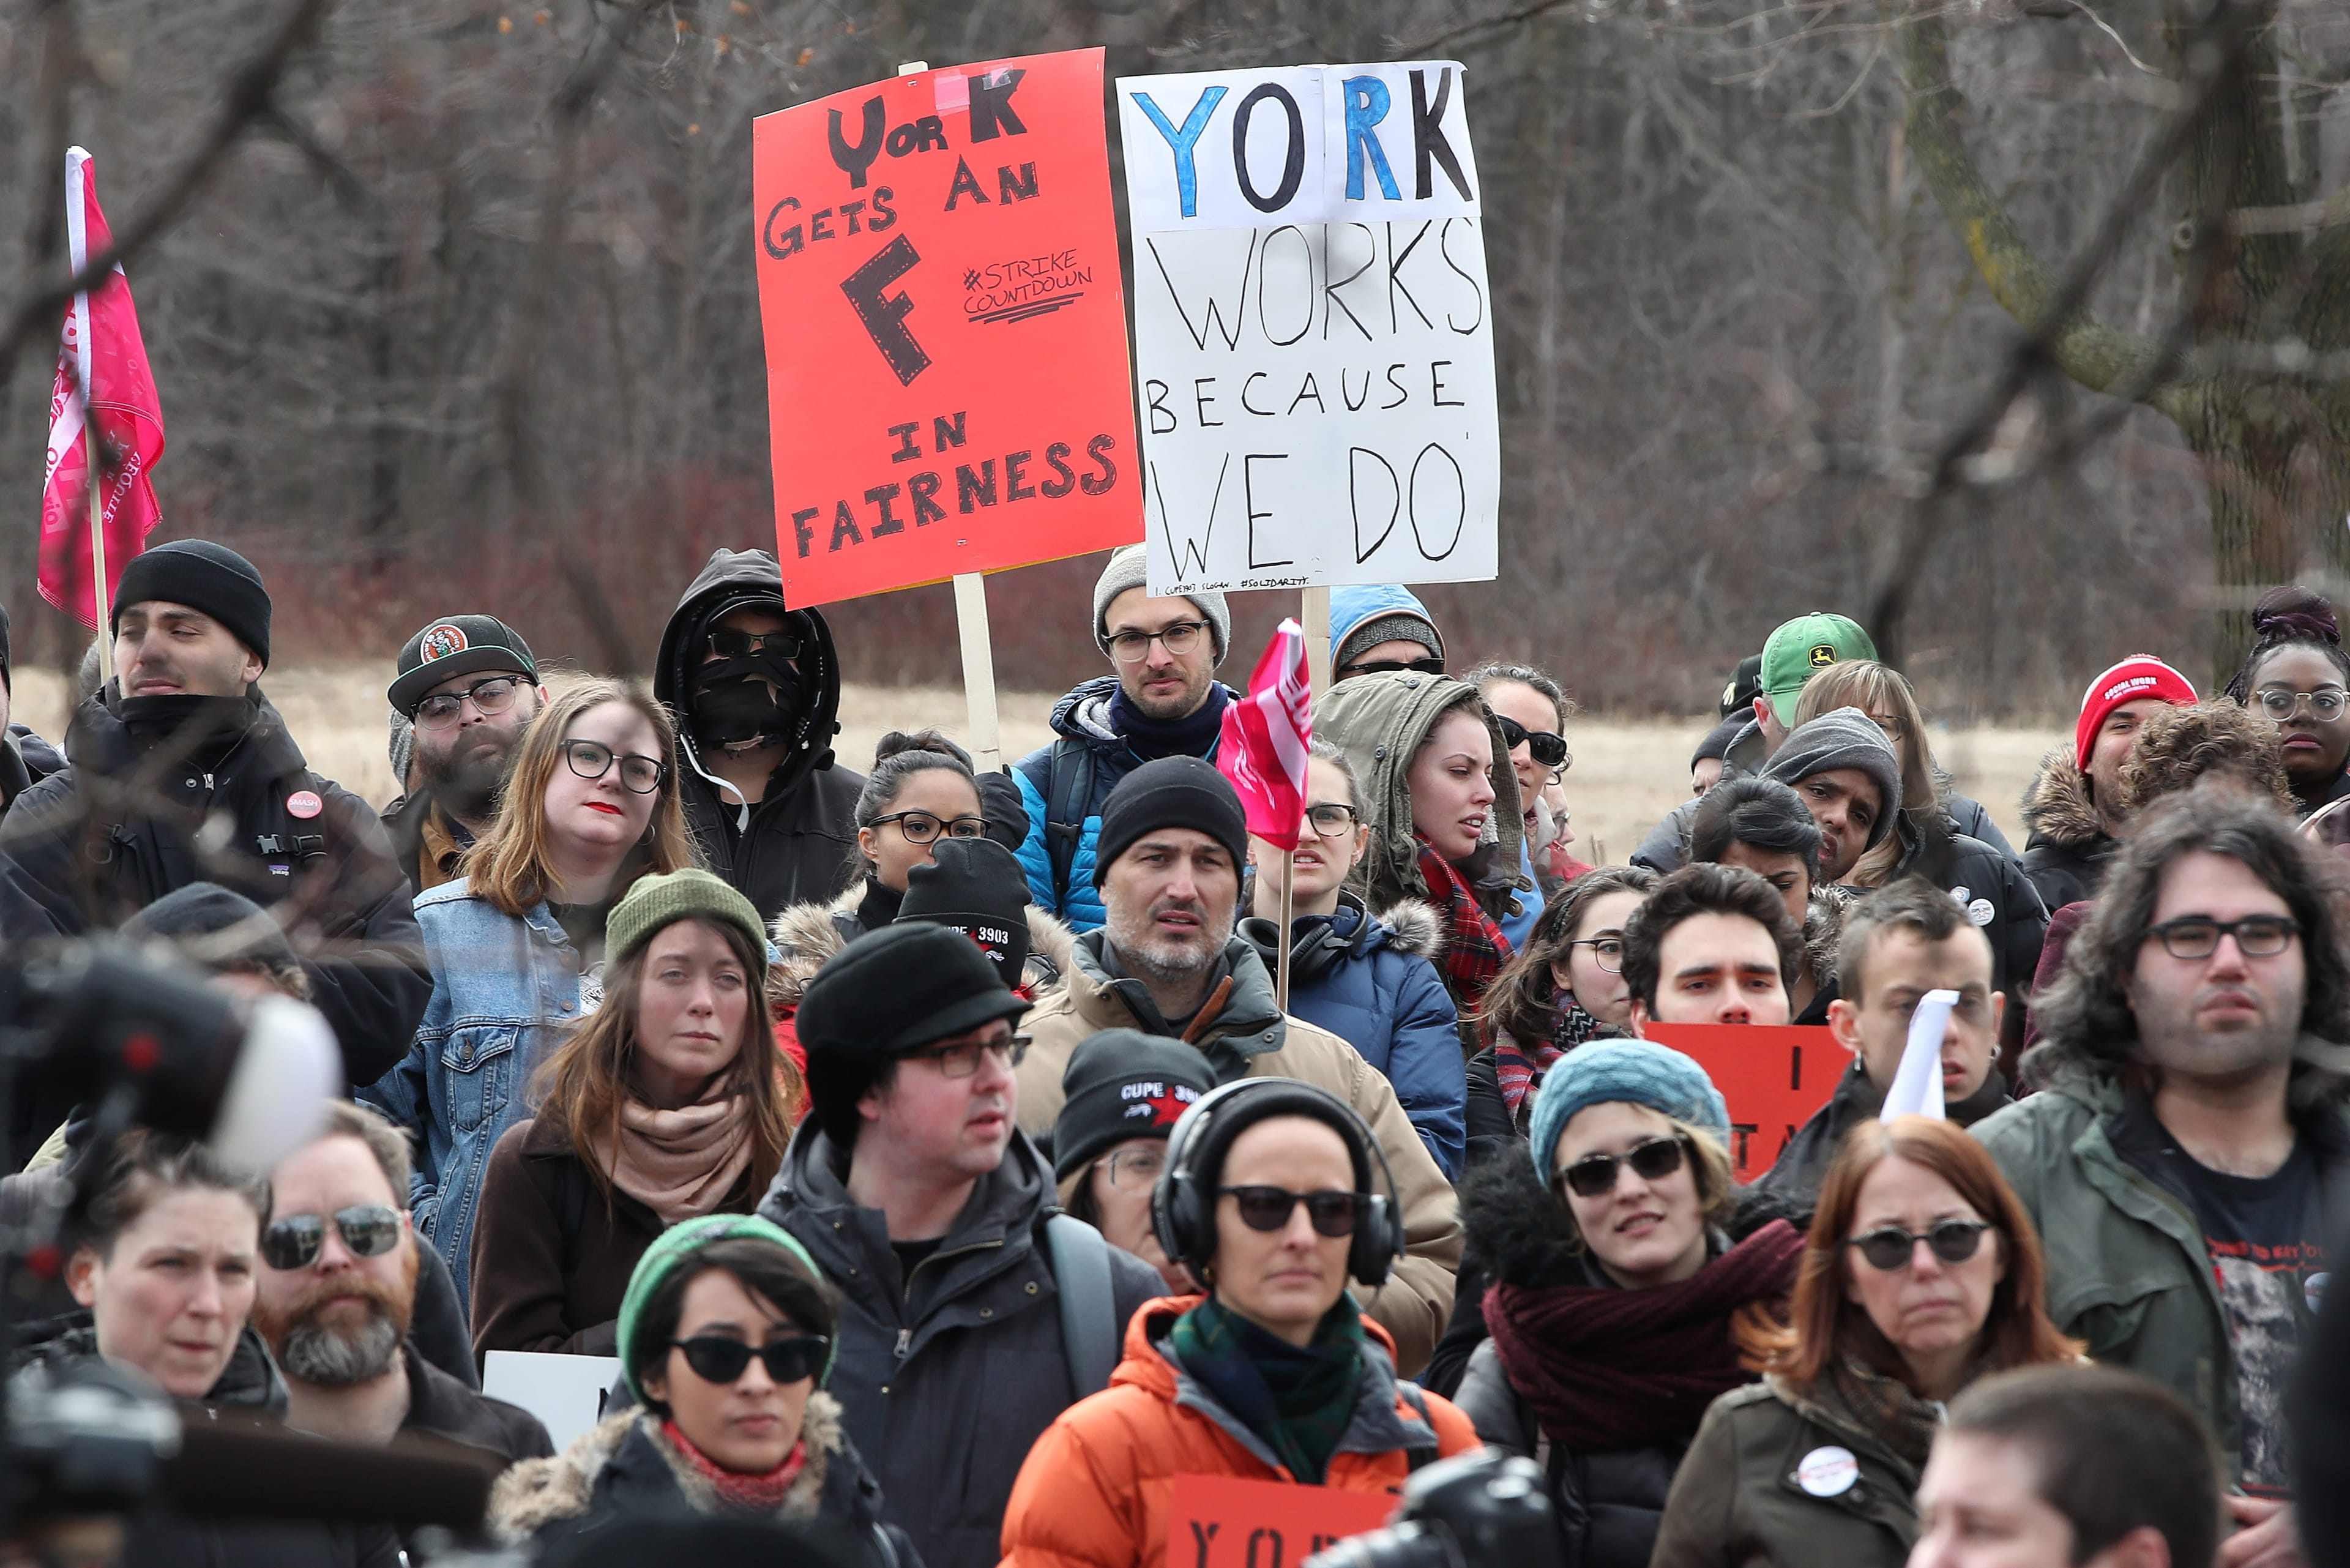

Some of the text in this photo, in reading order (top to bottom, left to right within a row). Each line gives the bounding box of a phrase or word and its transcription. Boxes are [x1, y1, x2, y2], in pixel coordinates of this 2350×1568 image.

[1130, 67, 1474, 219] YORK
[944, 154, 1040, 211] AN
[963, 248, 1077, 291] #STRIKE
[964, 267, 1092, 313] COUNTDOWN
[1146, 217, 1482, 351] WORKS
[840, 233, 932, 387] F
[1146, 360, 1464, 434] BECAUSE
[888, 411, 966, 463] IN
[792, 434, 1117, 558] FAIRNESS
[1151, 442, 1464, 581] WE DO
[2105, 677, 2157, 700] SOCIAL WORK
[978, 927, 1008, 944] 3903
[1121, 1082, 1164, 1100] CUPE
[1791, 1046, 1801, 1090] I
